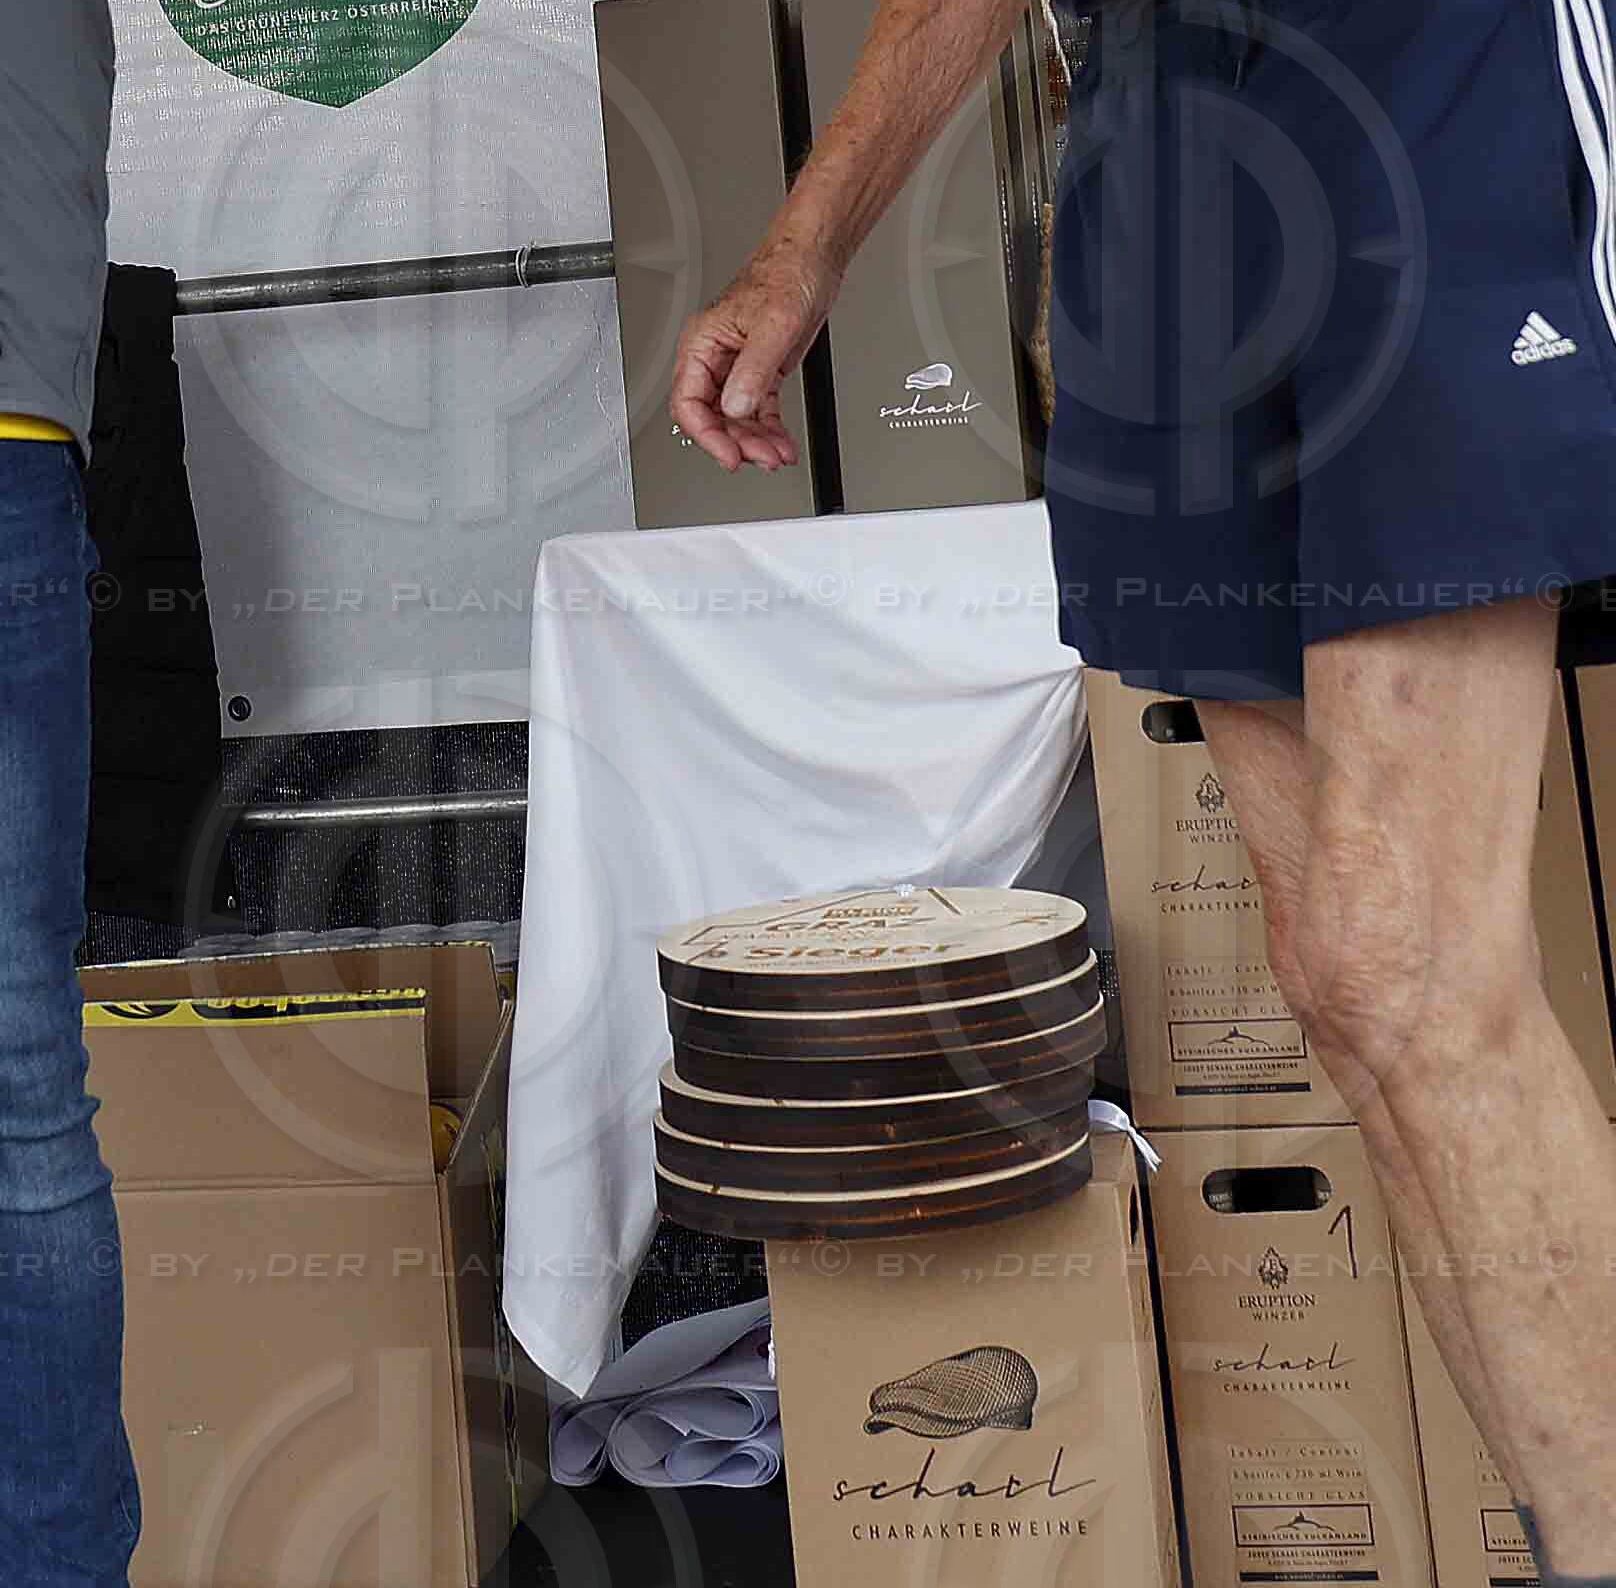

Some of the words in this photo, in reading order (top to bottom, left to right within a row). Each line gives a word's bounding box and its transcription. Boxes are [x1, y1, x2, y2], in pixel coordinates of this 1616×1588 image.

[1327, 1204, 1358, 1280] 1
[1237, 1293, 1316, 1310] ERUPTION
[851, 1518, 1092, 1543] CHARAKTERWEINE
